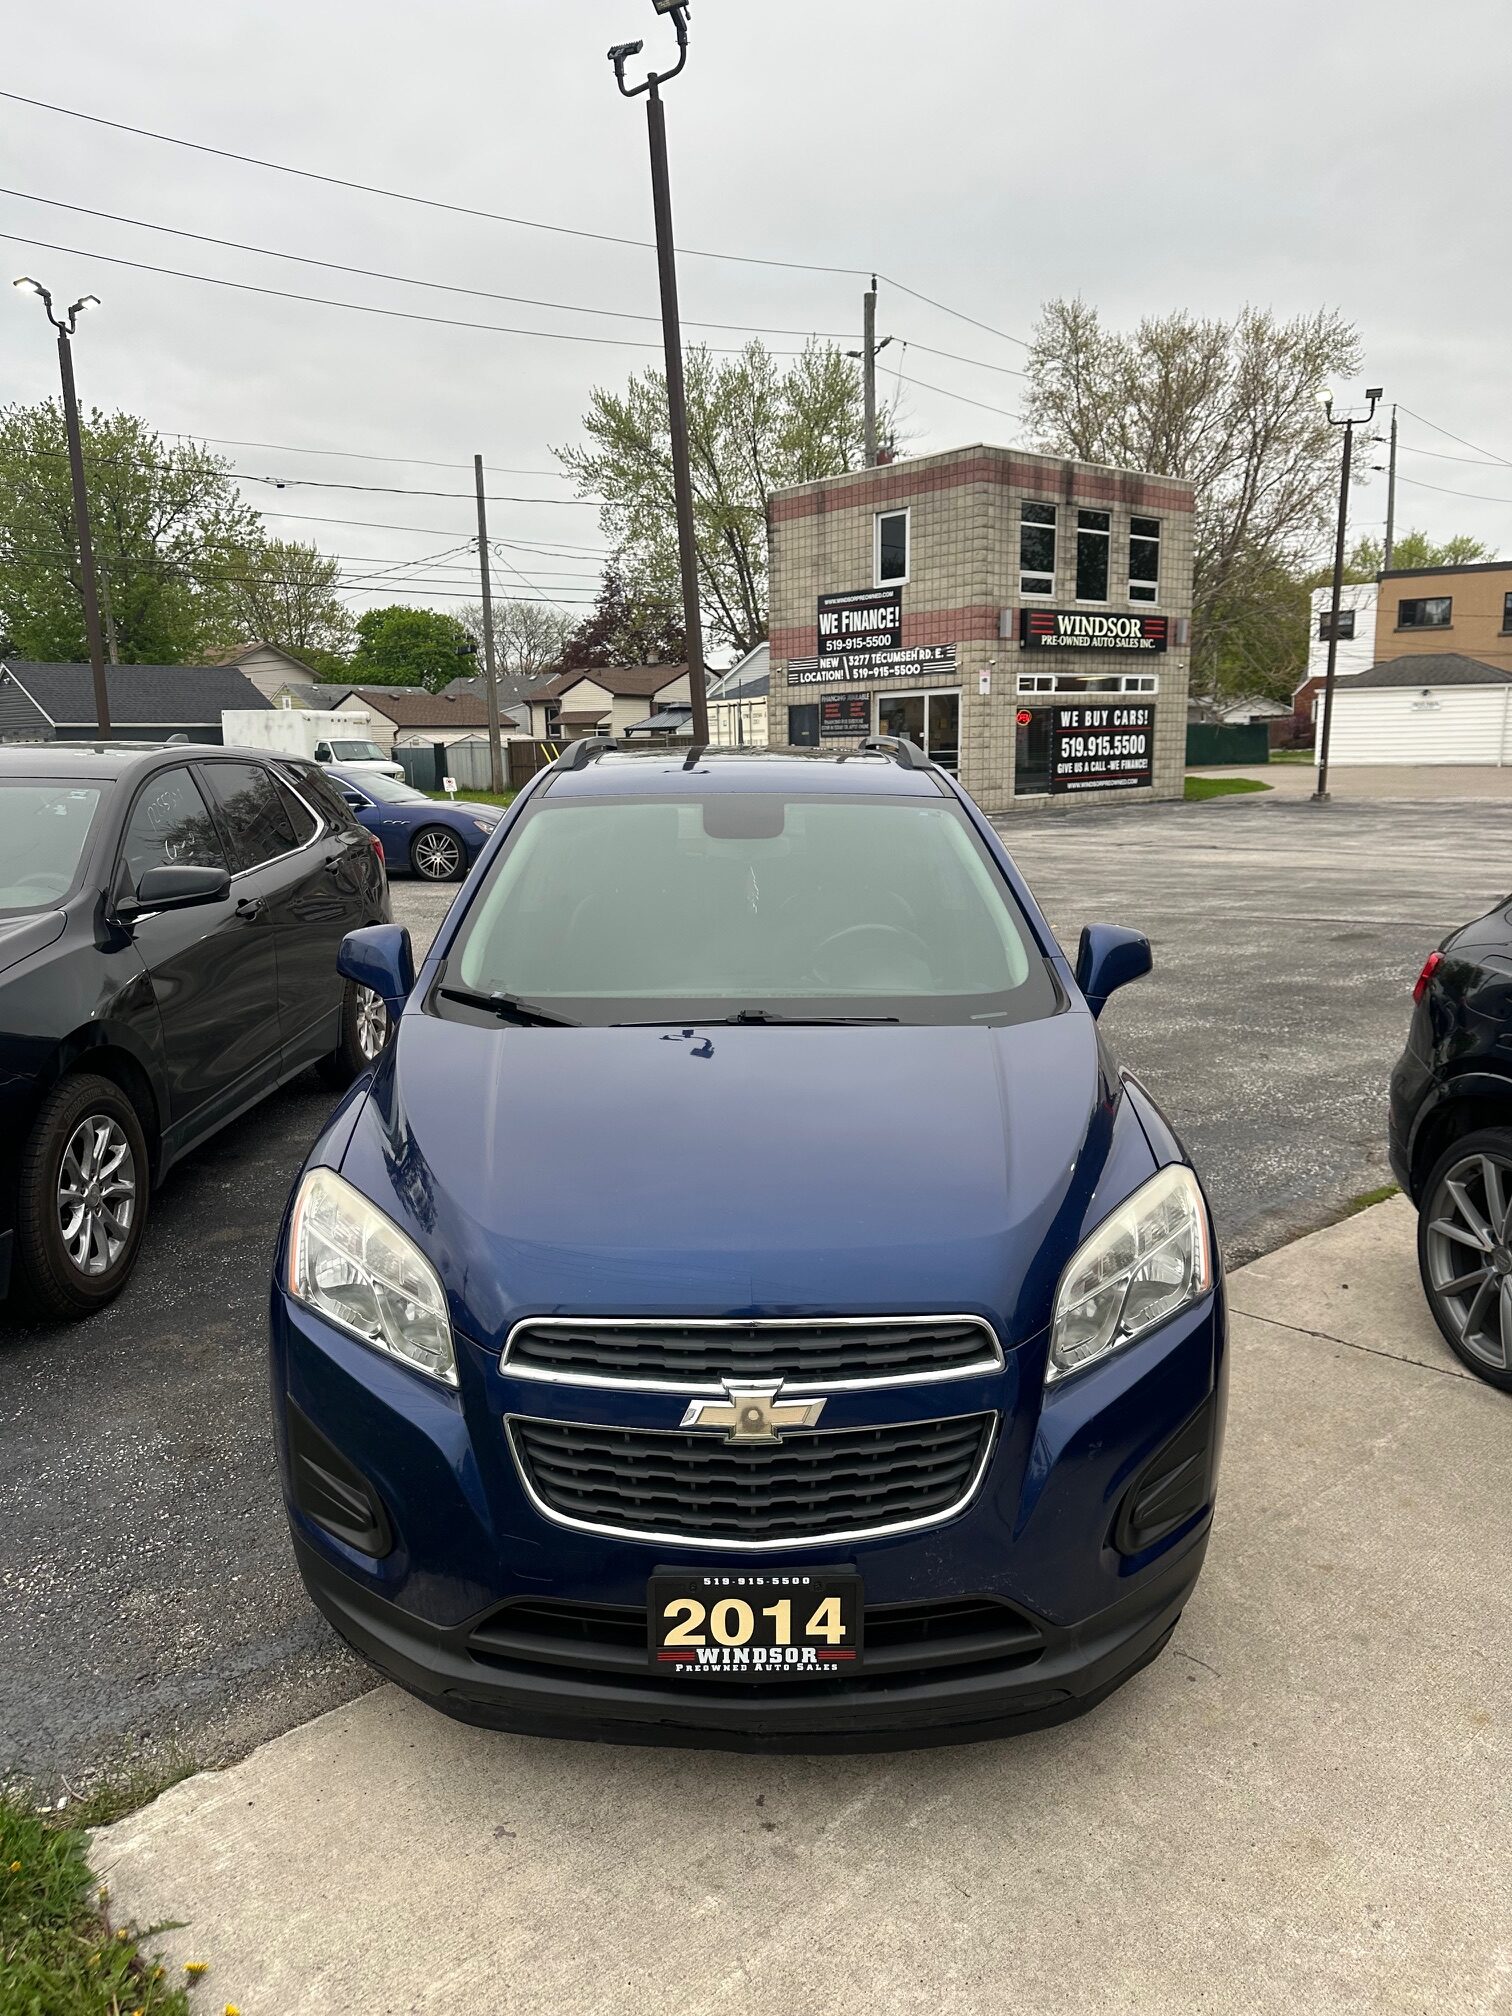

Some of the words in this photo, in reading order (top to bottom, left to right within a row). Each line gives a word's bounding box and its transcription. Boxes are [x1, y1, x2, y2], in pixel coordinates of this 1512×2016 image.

[819, 613, 838, 635] WE
[842, 606, 899, 633] FINANCE!
[1057, 615, 1142, 637] WINDSOR
[826, 634, 891, 651] 519-915-5500
[1041, 635, 1090, 647] PRE-OWNED
[1091, 637, 1115, 647] AUTO
[1116, 638, 1139, 648] SALES
[1140, 639, 1156, 648] INC.
[820, 657, 839, 669] NEW
[848, 654, 870, 666] 3277
[871, 651, 918, 665] TECUMSEH
[919, 649, 934, 660] RD.
[935, 648, 944, 659] E.
[800, 670, 844, 683] LOCATION!
[853, 664, 921, 679] 519-915-5500
[1060, 710, 1079, 727] WE
[1085, 710, 1109, 727] BUY
[1114, 709, 1148, 726] CARS!
[1061, 734, 1146, 758] 519.915.5500
[1057, 762, 1073, 774] GIVE
[1074, 762, 1083, 773] US
[1084, 761, 1089, 772] A
[1090, 760, 1106, 772] CALL
[1121, 758, 1148, 770] FINANCE!
[703, 1577, 810, 1585] 519-915-5500
[663, 1597, 846, 1646] 2014
[695, 1647, 817, 1664] WINDSOR
